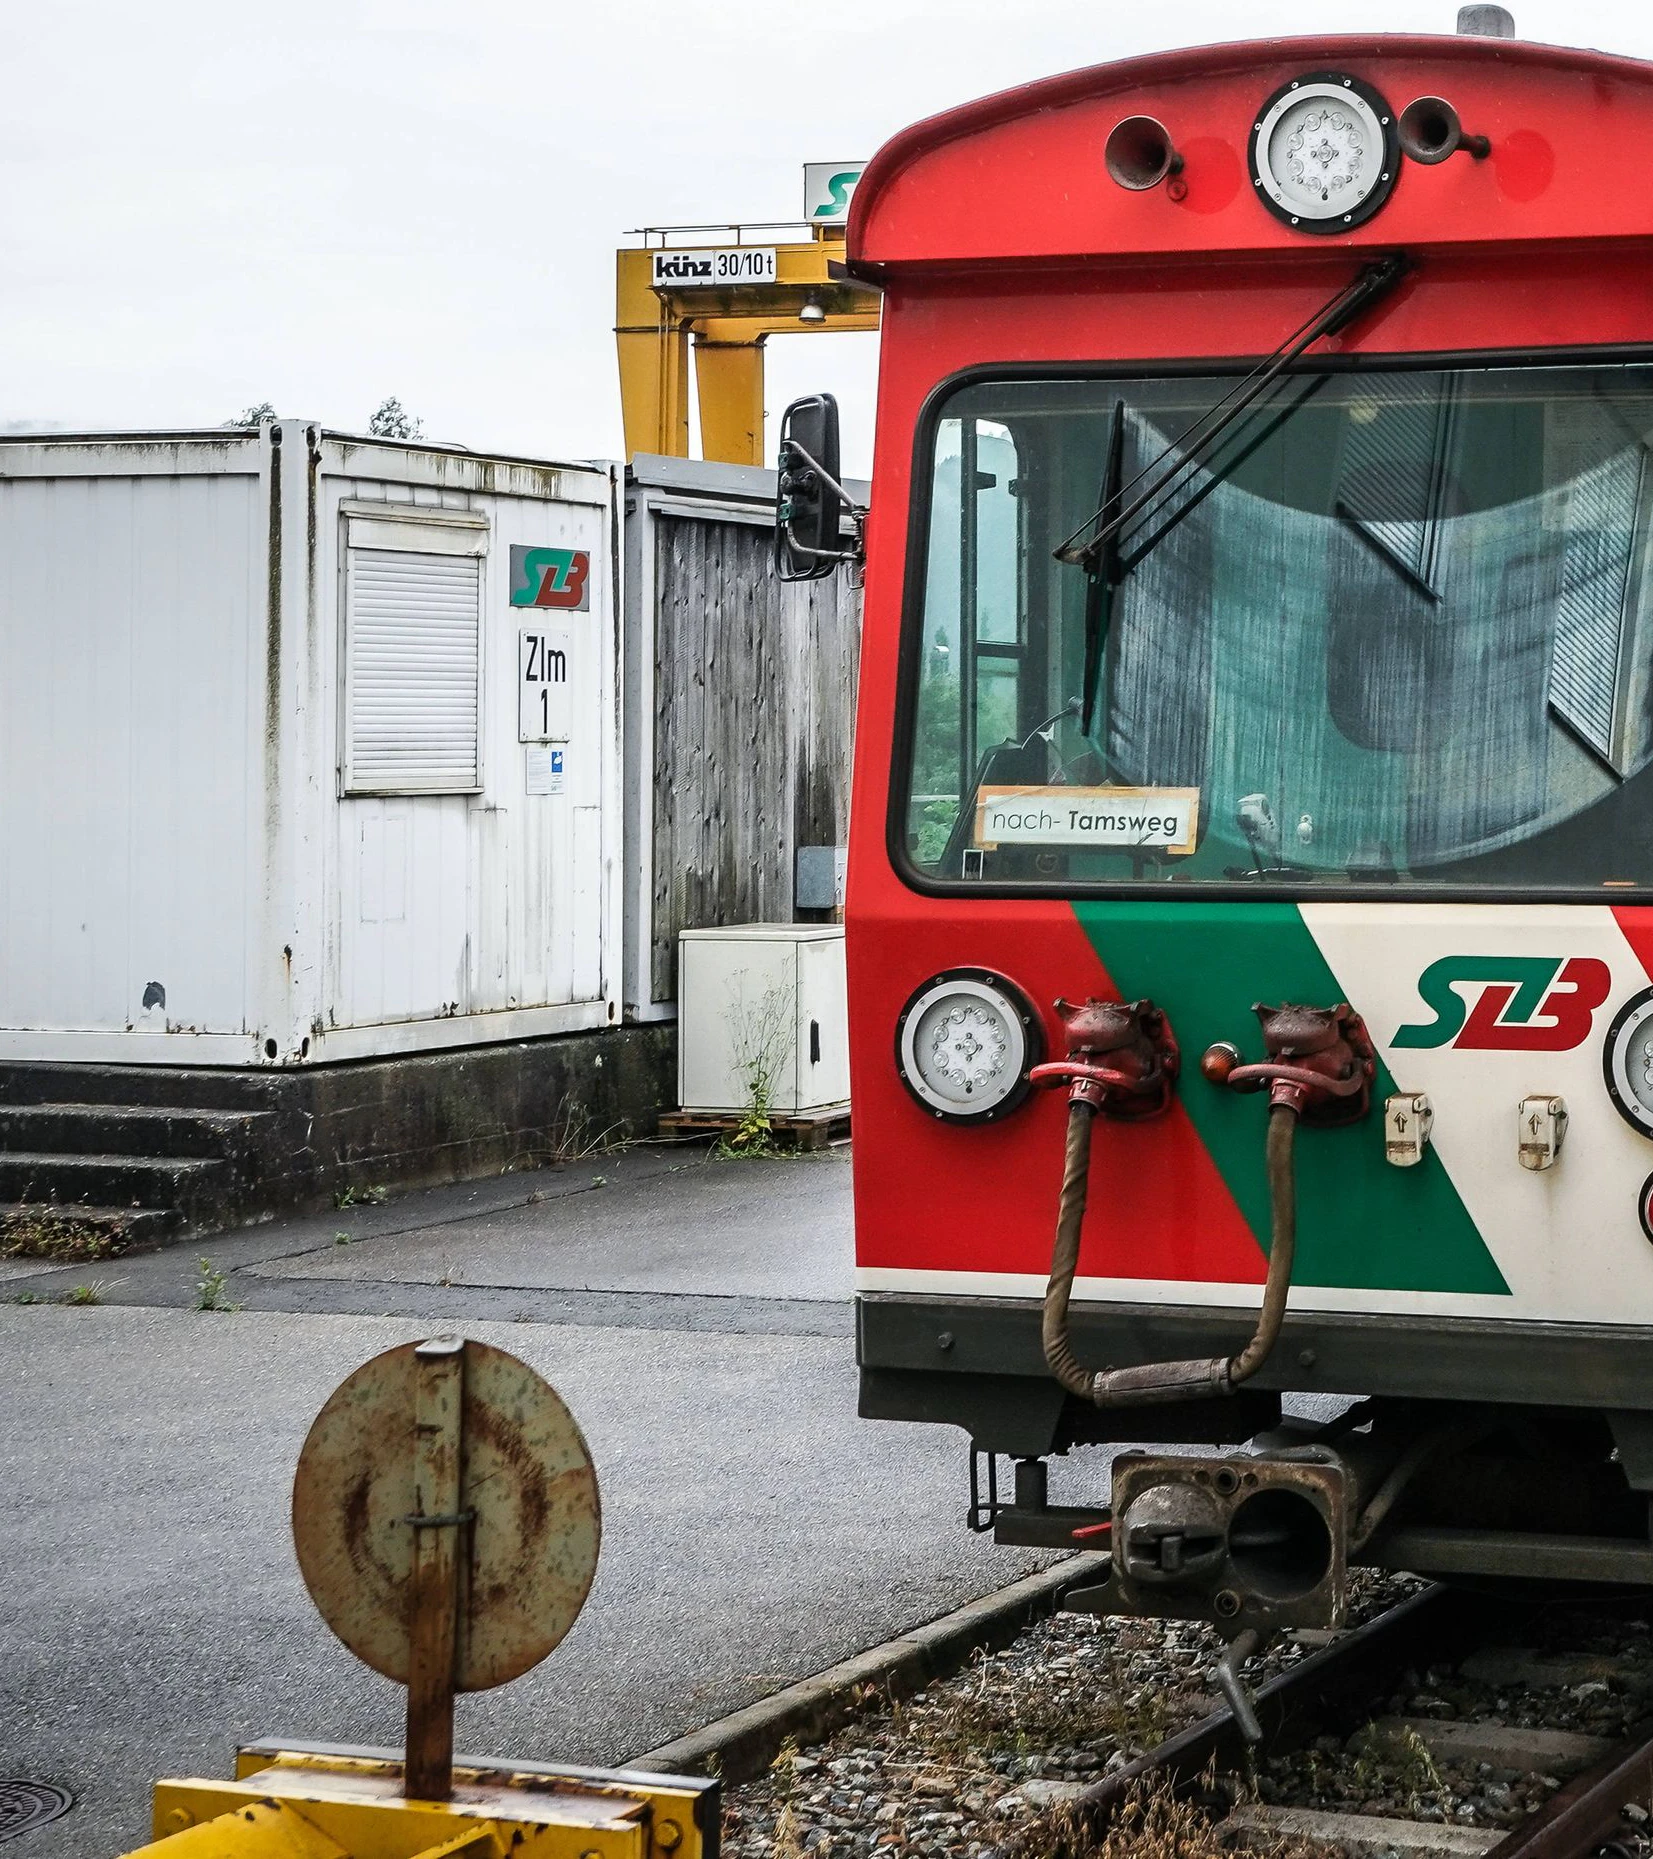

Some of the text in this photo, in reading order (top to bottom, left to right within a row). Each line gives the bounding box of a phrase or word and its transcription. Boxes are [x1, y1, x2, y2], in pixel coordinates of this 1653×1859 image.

[656, 253, 773, 277] künz 30/10 t
[540, 689, 547, 734] 1
[992, 810, 1178, 837] nach- Tamsweg
[1388, 955, 1612, 1052] SLB
